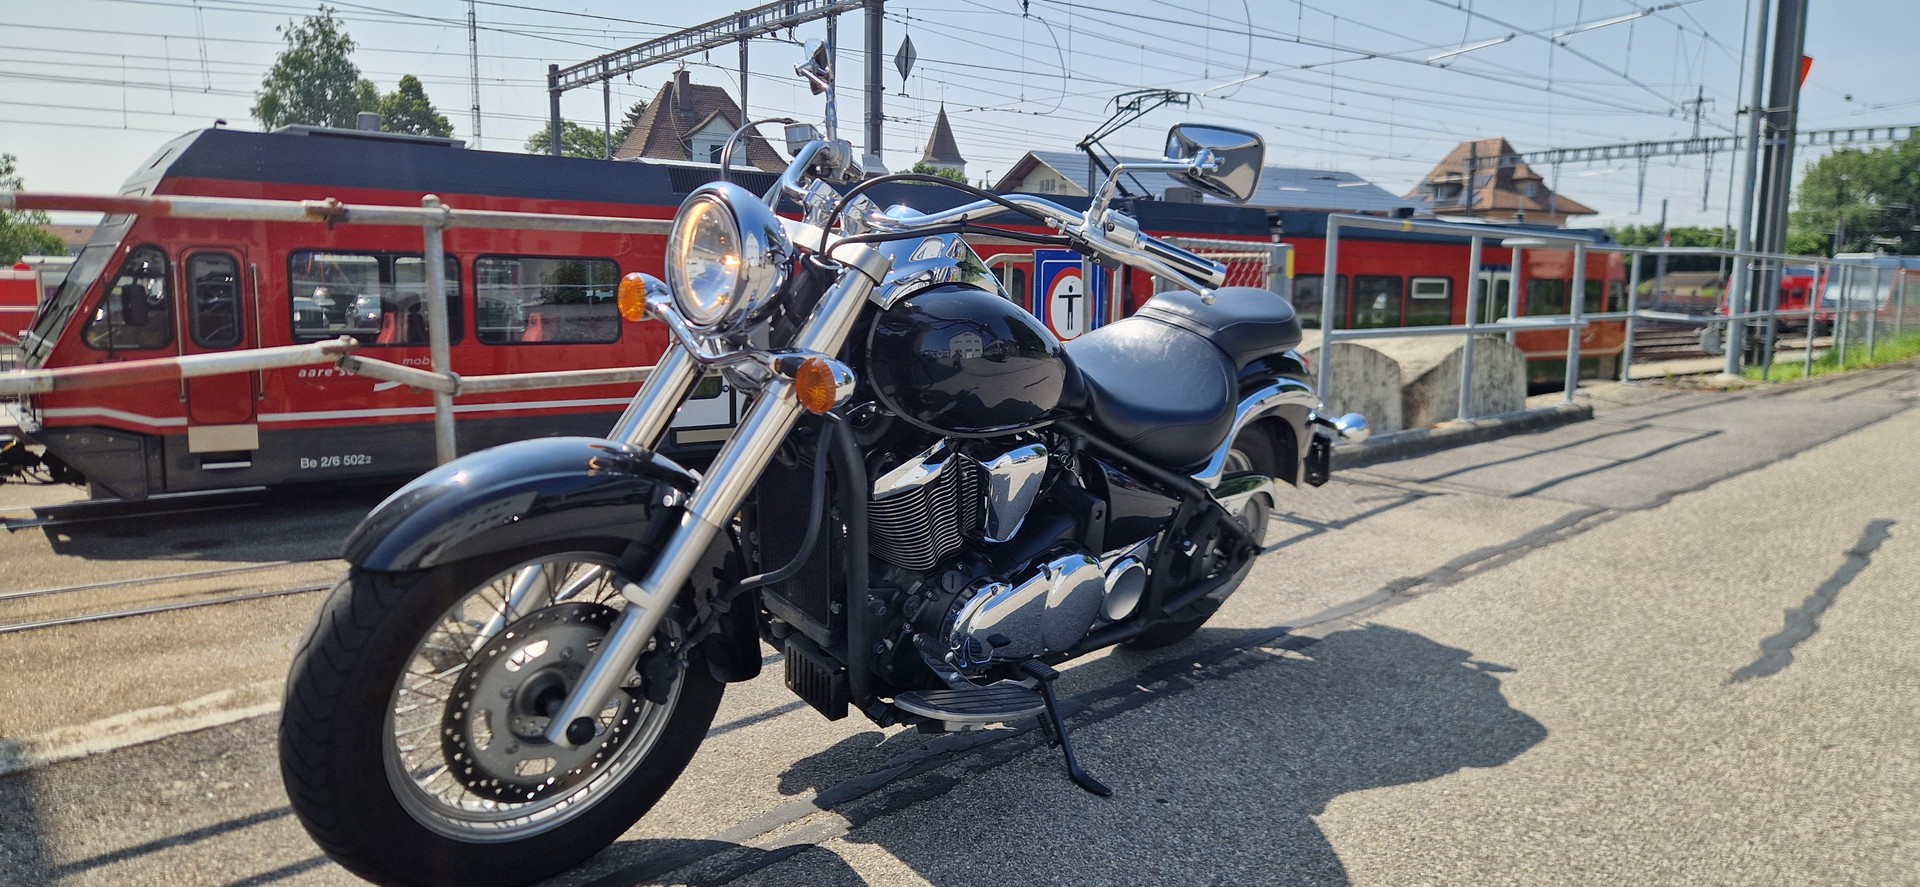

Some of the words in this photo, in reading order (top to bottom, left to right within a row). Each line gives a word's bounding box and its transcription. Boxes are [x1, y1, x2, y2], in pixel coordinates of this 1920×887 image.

[298, 368, 333, 378] aare
[300, 457, 317, 469] Be
[320, 455, 340, 468] 2/6
